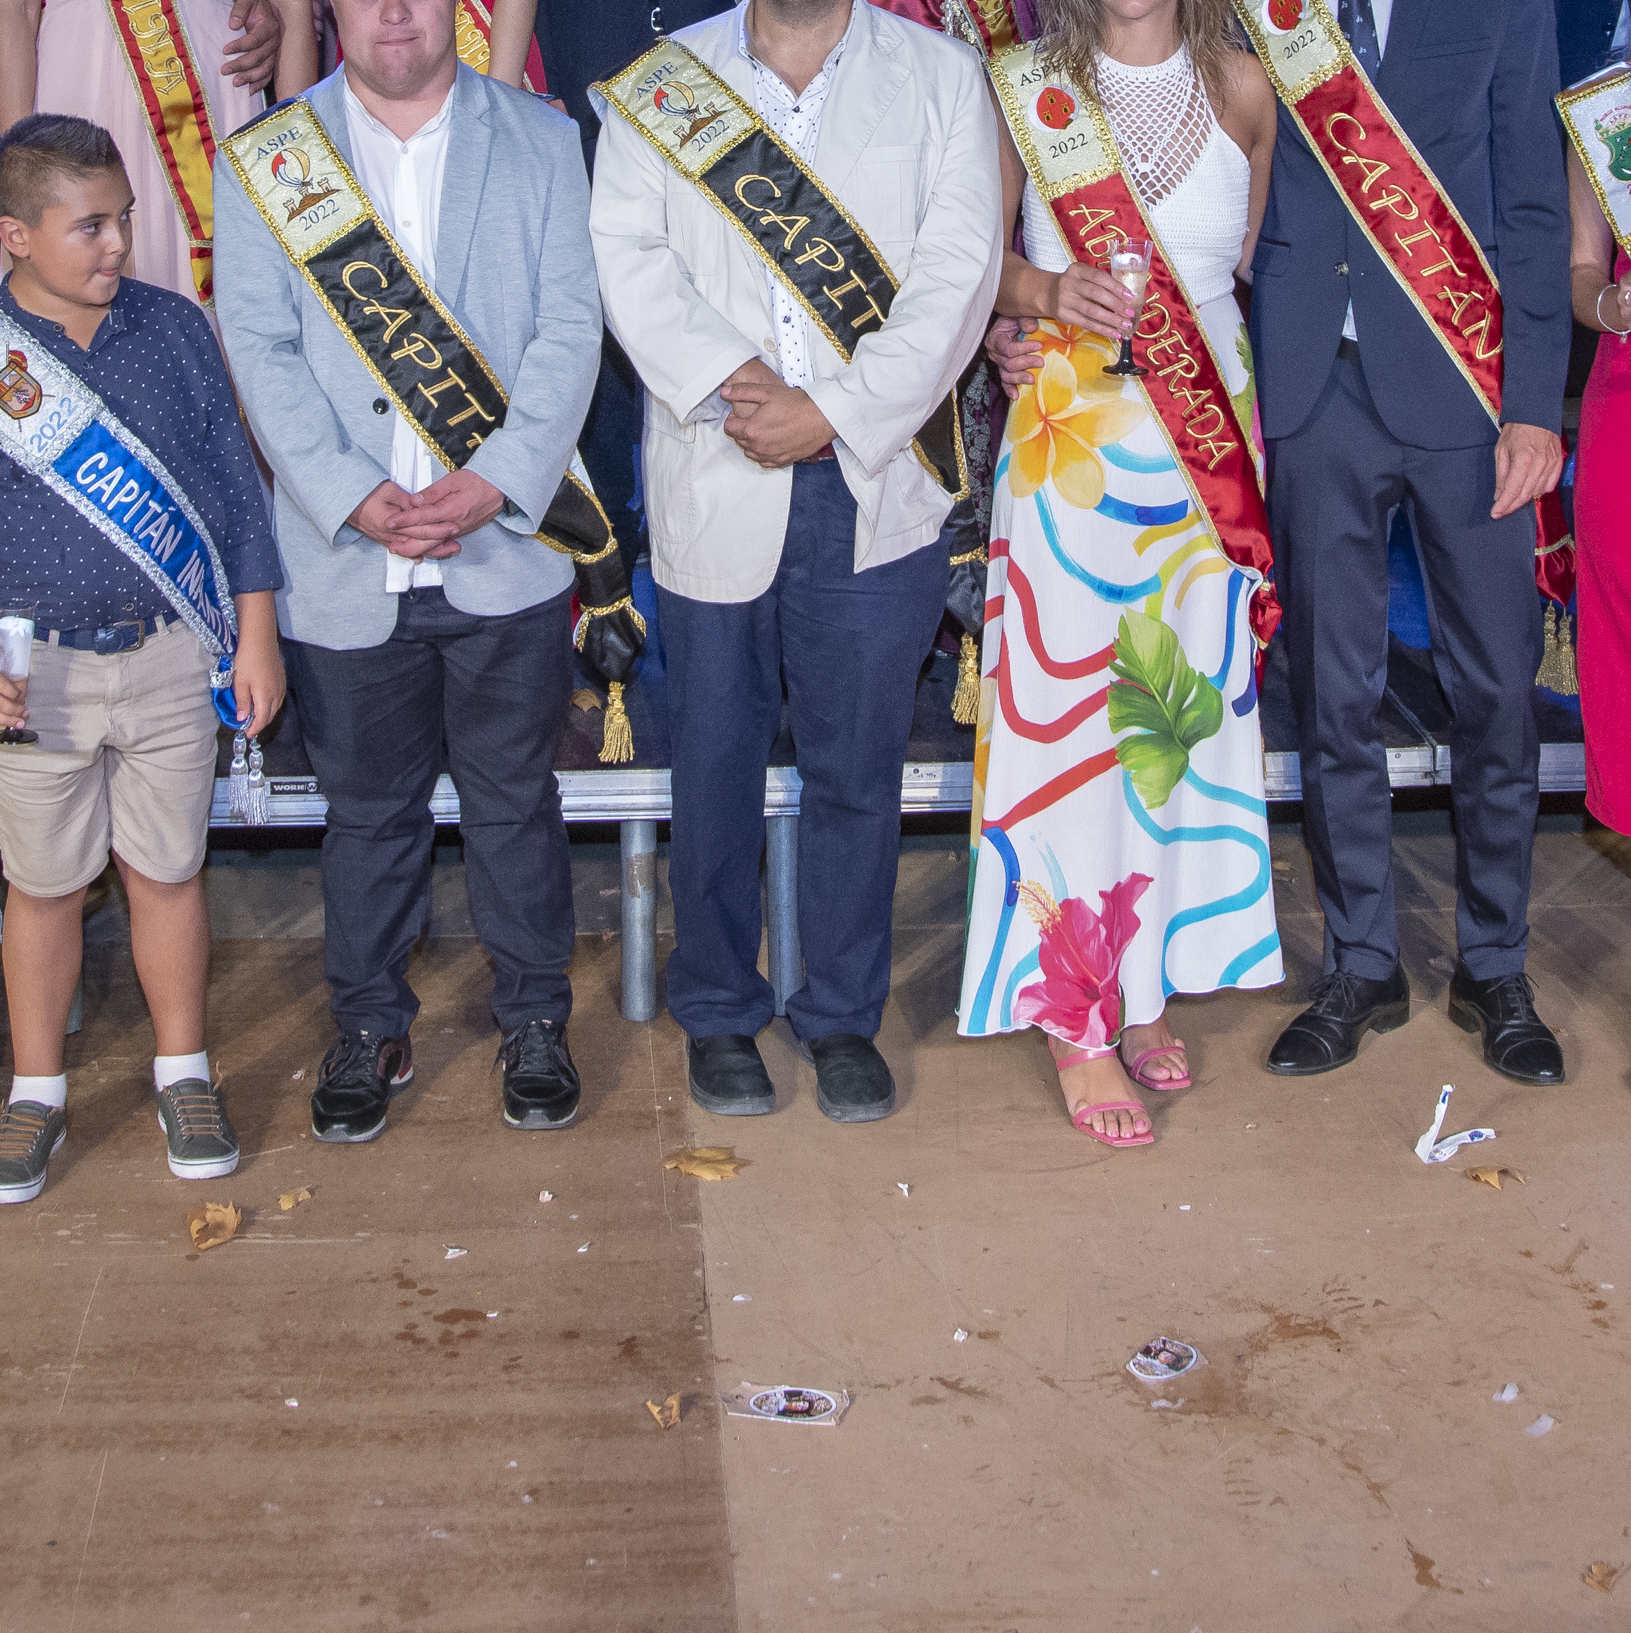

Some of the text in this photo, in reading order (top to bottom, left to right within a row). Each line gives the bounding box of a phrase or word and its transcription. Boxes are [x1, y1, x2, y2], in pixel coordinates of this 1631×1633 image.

[1282, 28, 1317, 60] 2022
[635, 61, 678, 100] ASPE
[255, 126, 304, 161] ASPE
[691, 119, 730, 152] 2022
[1048, 132, 1089, 160] 2022
[298, 199, 340, 231] 2022
[734, 174, 887, 329] CAPIT
[30, 396, 79, 453] 2022
[75, 452, 183, 564] CAPITÁN
